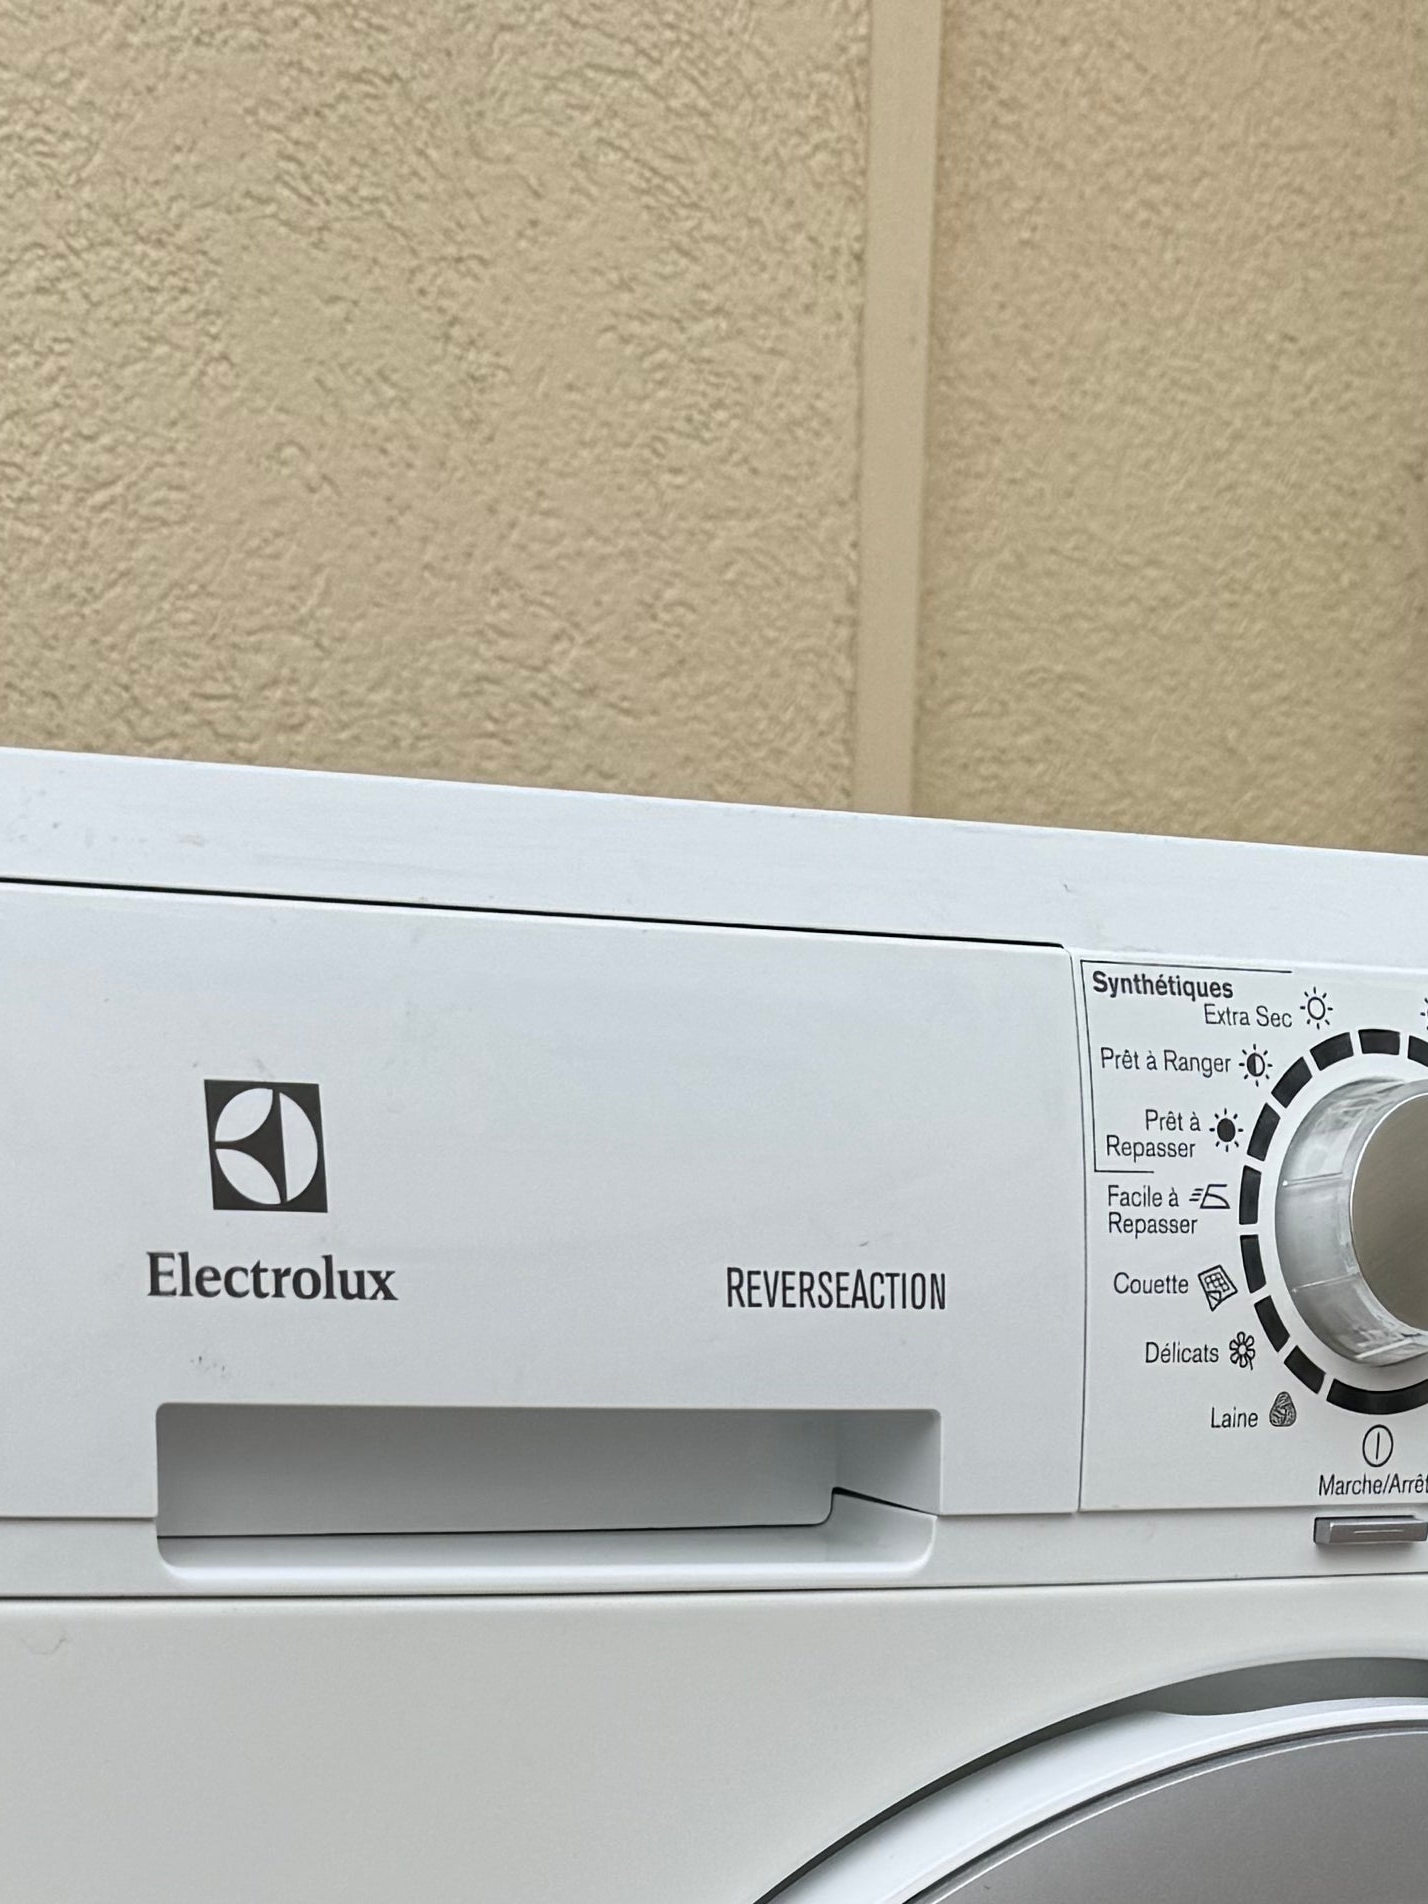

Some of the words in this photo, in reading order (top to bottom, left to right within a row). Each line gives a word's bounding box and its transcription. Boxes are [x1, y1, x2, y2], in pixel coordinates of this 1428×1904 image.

[1092, 970, 1234, 1001] Synthétiques
[1203, 1003, 1251, 1026] Extra
[1255, 1005, 1293, 1028] Sec
[1100, 1046, 1140, 1070] Prêt
[1146, 1050, 1158, 1071] à
[1163, 1049, 1232, 1078] Ranger
[1145, 1108, 1184, 1131] Prêt
[1189, 1111, 1201, 1132] à
[1106, 1134, 1196, 1163] Repasser
[1108, 1185, 1163, 1207] Facile
[1168, 1186, 1180, 1208] à
[1108, 1212, 1199, 1240] Repasser
[146, 1251, 400, 1302] Electrolux
[726, 1266, 947, 1310] REVERSEACTION
[1113, 1271, 1190, 1295] Couette
[1145, 1341, 1220, 1364] Délicats
[1210, 1406, 1259, 1429] Laine
